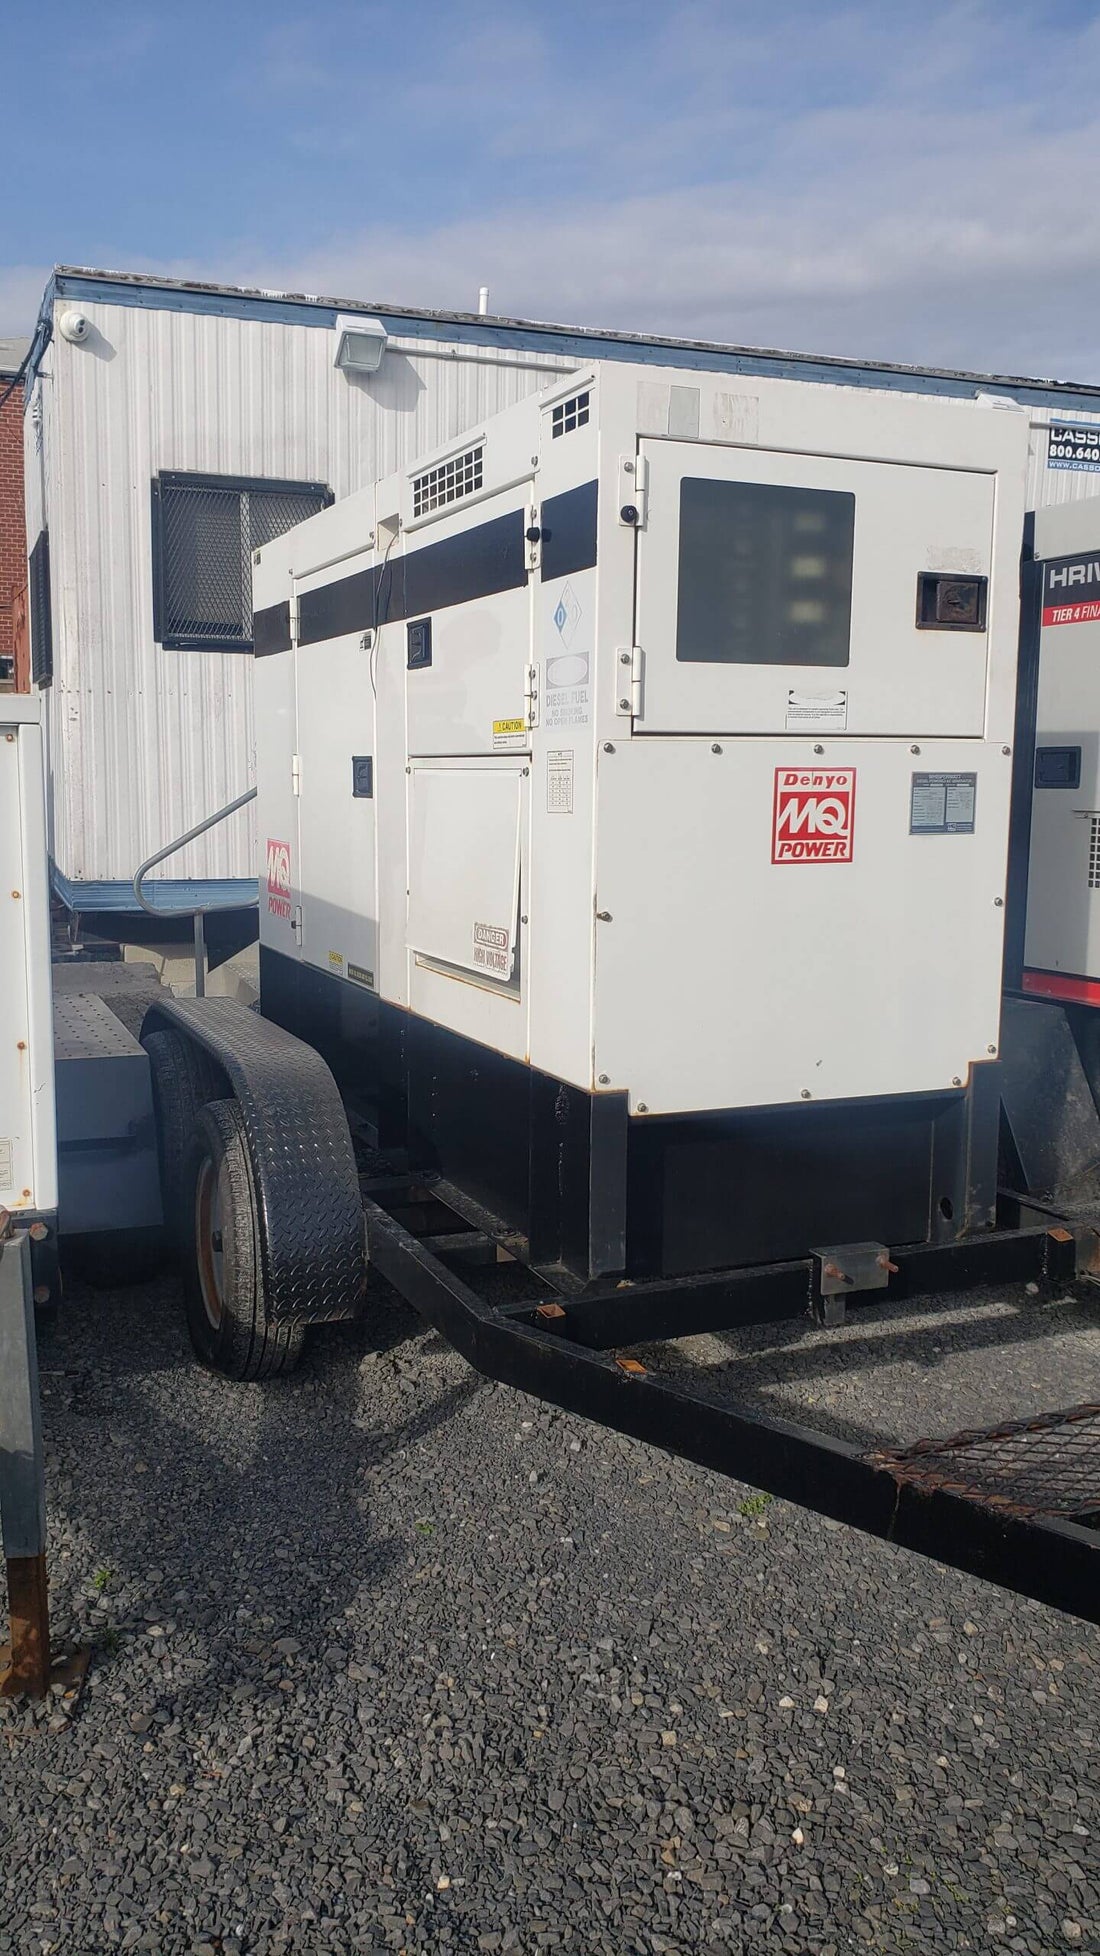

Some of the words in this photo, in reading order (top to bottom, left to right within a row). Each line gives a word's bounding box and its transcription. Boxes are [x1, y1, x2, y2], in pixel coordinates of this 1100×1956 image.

[1051, 428, 1100, 446] CASS
[1052, 608, 1073, 623] TIER
[1074, 607, 1081, 619] 4
[502, 721, 522, 731] CAUTION
[783, 773, 848, 789] Denyo
[778, 797, 848, 837] MQ
[778, 841, 847, 858] POWER
[267, 845, 290, 891] MQ
[268, 896, 291, 920] POWER
[477, 928, 505, 946] DANGER
